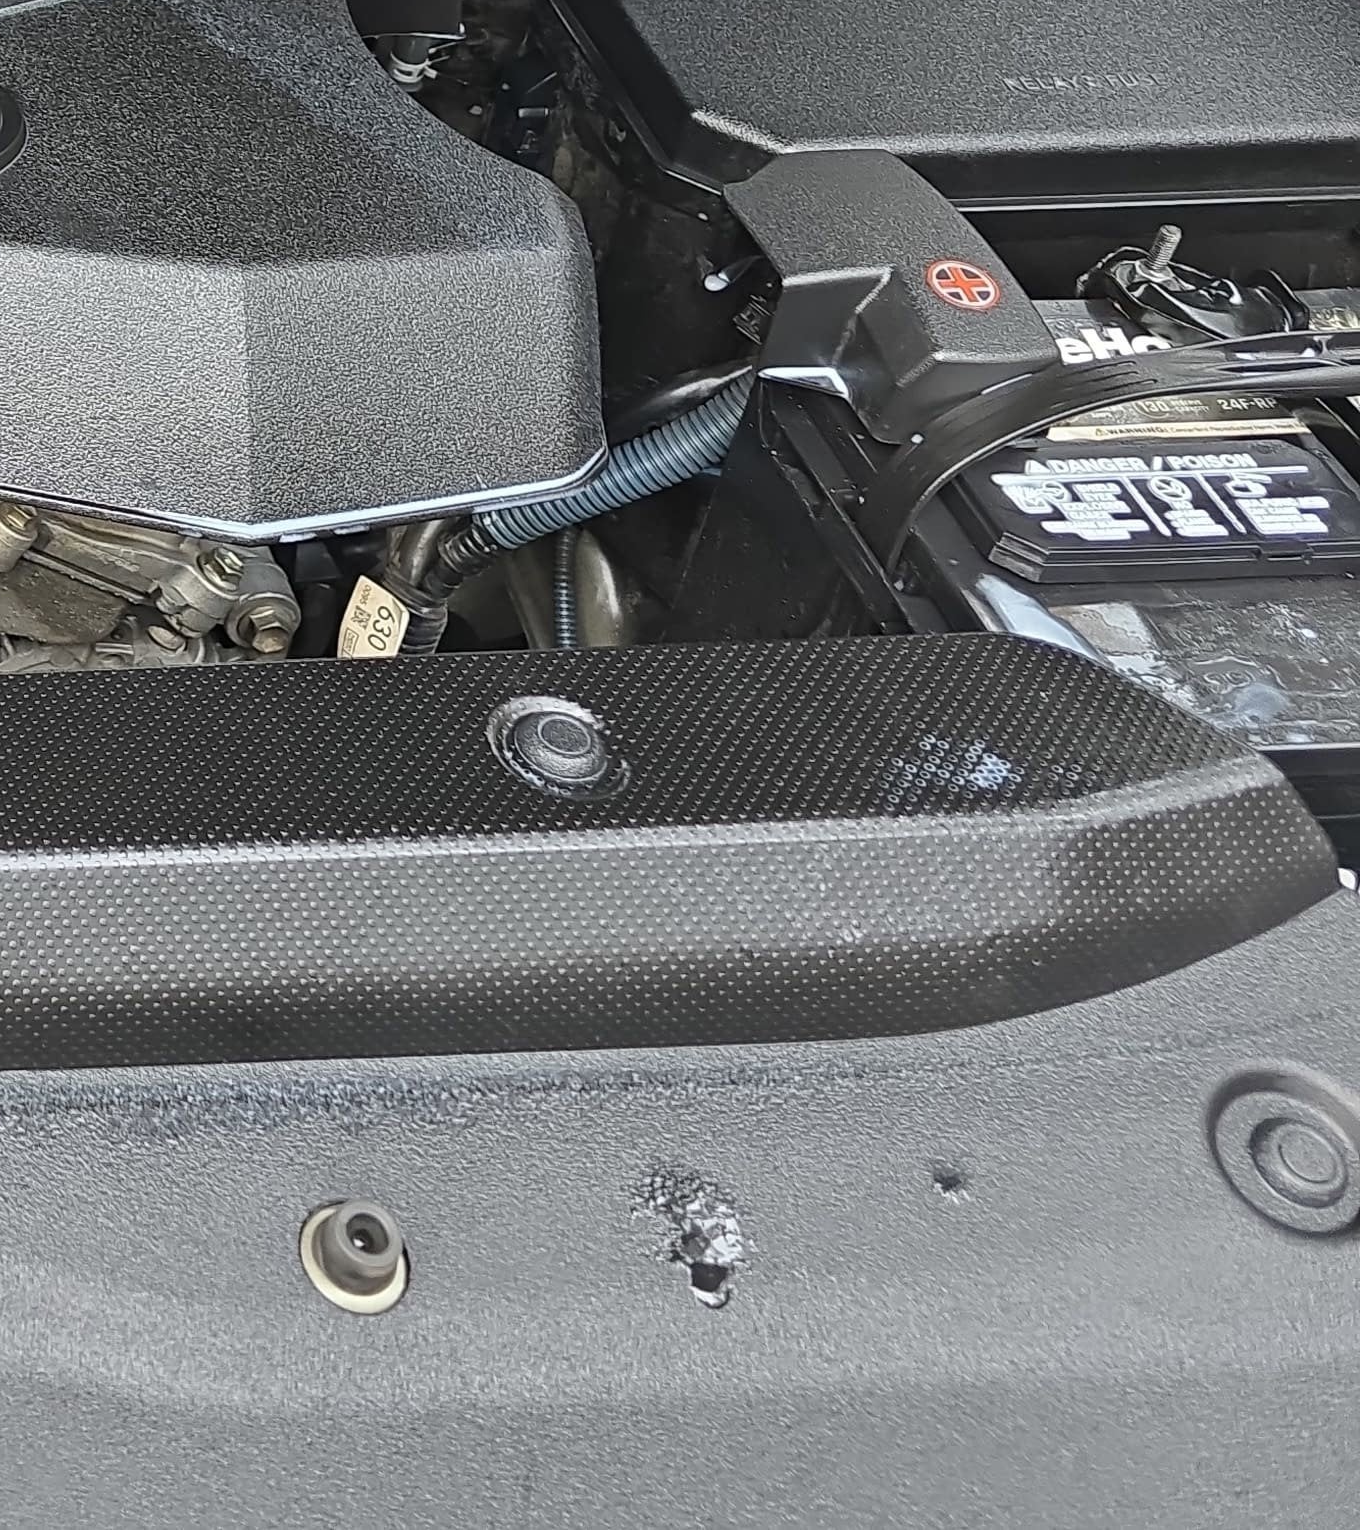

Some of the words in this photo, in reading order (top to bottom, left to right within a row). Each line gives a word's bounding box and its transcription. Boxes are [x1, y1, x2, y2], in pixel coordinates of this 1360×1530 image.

[1046, 456, 1148, 474] DANGER
[1166, 453, 1257, 470] POISON
[367, 605, 396, 652] 630
